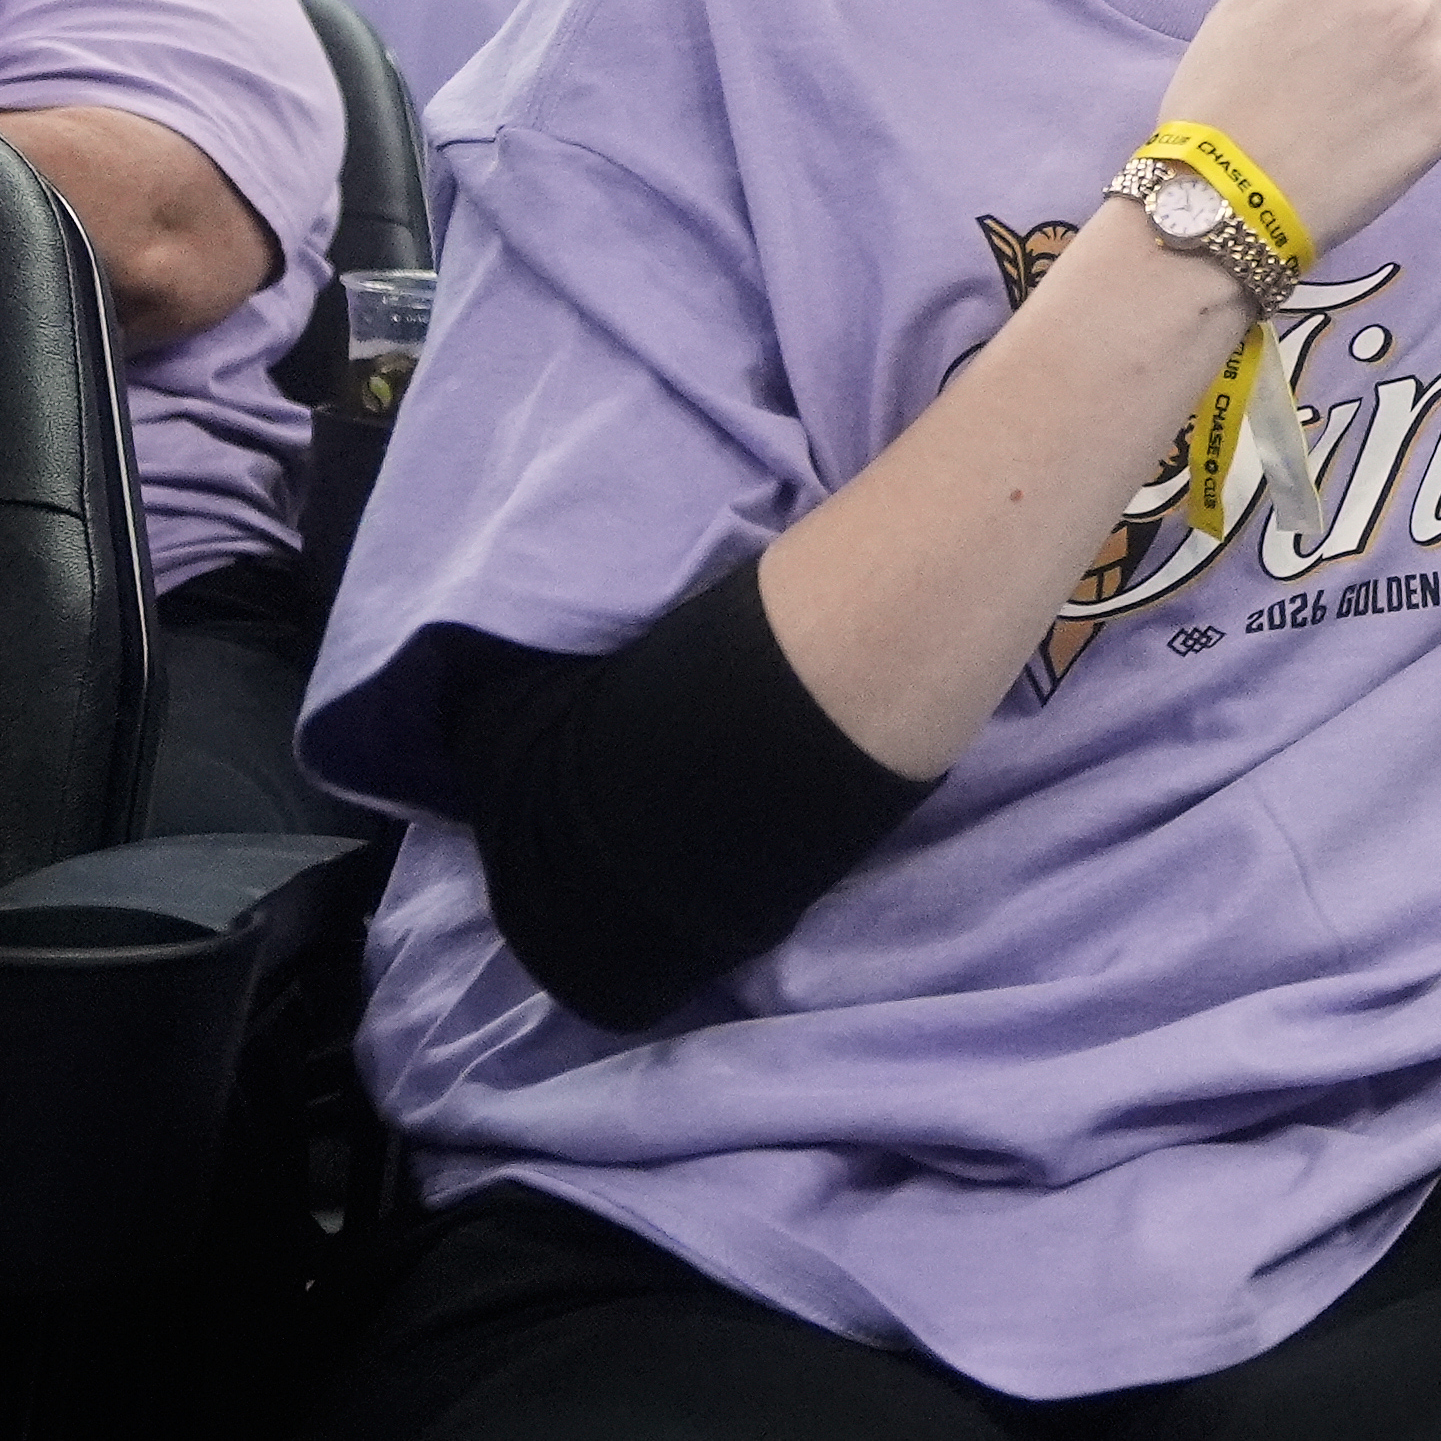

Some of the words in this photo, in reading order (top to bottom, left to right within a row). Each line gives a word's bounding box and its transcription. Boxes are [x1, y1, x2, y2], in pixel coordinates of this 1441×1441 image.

[1196, 141, 1252, 193] CHASE
[1259, 210, 1288, 248] CLUB
[1206, 393, 1231, 457] CHASE
[1245, 589, 1326, 634] 2026
[1336, 571, 1441, 619] GOLDEN
